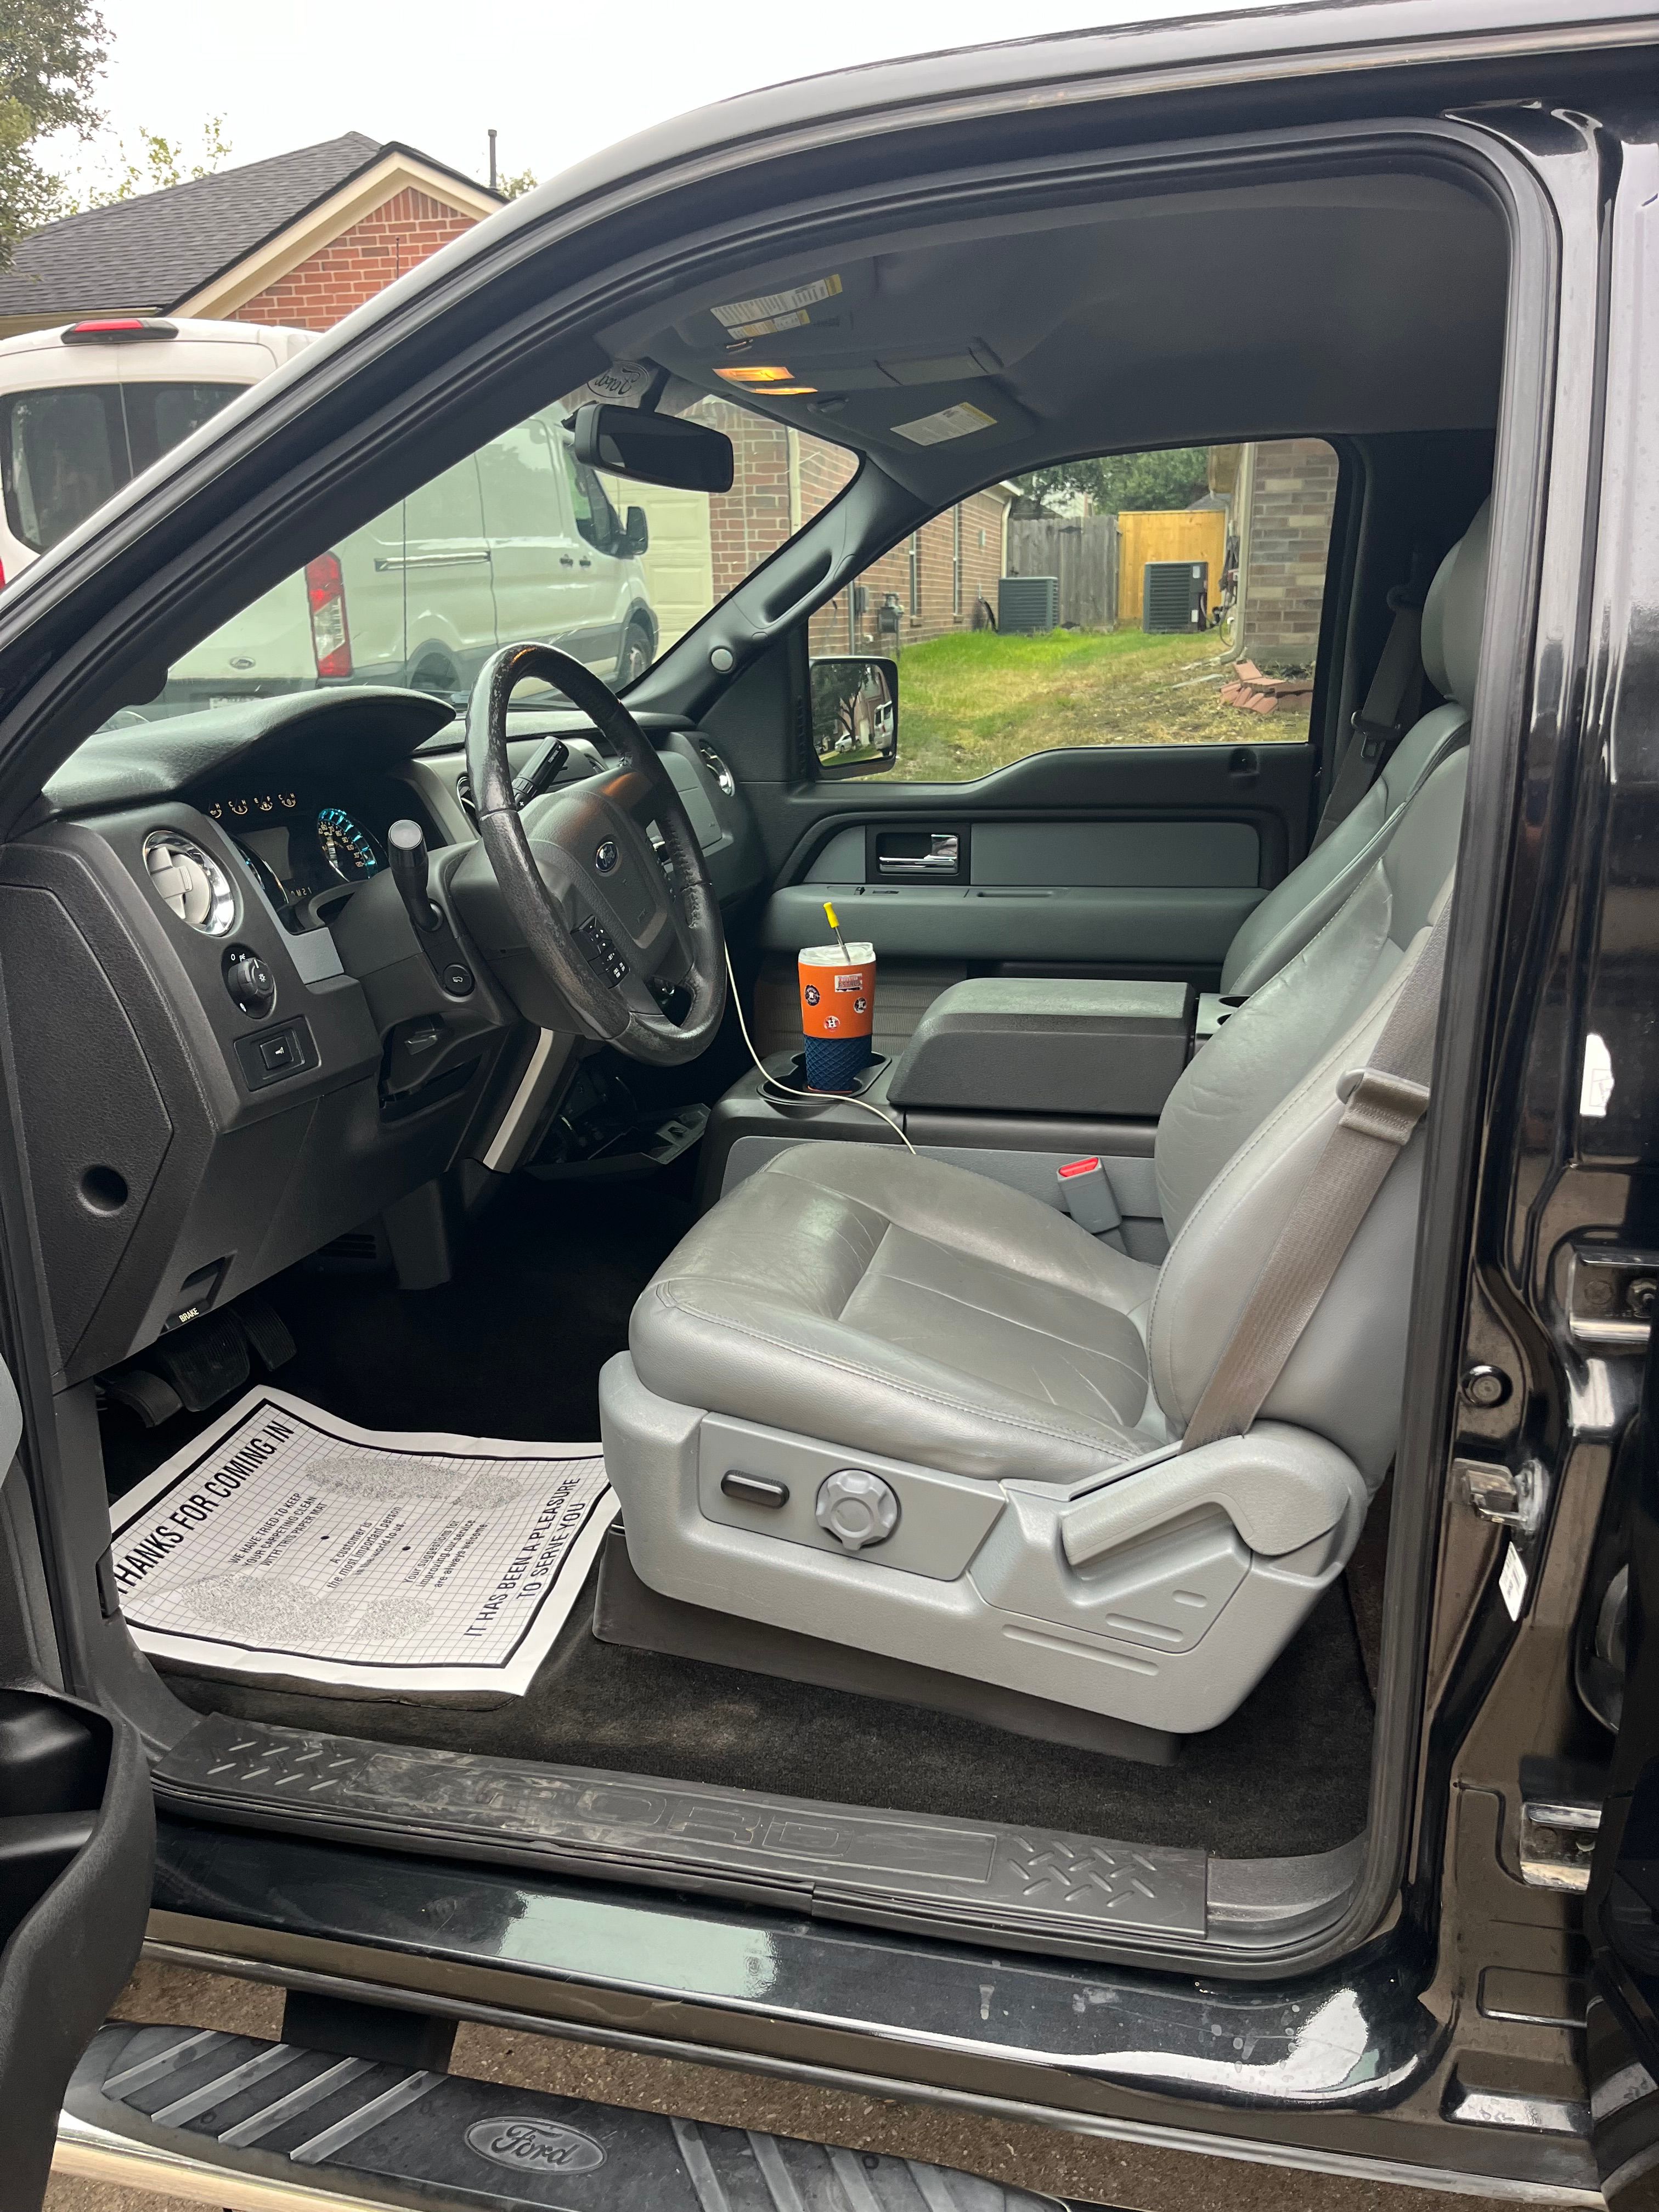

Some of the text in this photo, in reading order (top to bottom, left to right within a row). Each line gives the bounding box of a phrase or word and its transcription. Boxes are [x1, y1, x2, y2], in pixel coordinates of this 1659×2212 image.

[178, 1307, 199, 1322] BRAKE
[169, 1494, 219, 1531] FOR
[205, 1438, 278, 1498] COMING
[263, 1420, 295, 1443] IN
[228, 1492, 302, 1564] WE HAVE TRIED TO KEEP
[242, 1496, 318, 1566] YOUR CARPETING CLEAN
[261, 1502, 328, 1566] WITH THIS PAPER MAT
[326, 1577, 342, 1588] the
[339, 1558, 357, 1576] most
[380, 1506, 402, 1527] person
[336, 1528, 366, 1557] customer
[370, 1539, 391, 1557] world
[403, 1568, 421, 1583] Your
[417, 1530, 452, 1567] suggestions
[416, 1520, 476, 1587] improving our service
[464, 1477, 581, 1636] IT HAS BEEN A PLEASURE
[516, 1502, 585, 1599] TO SERVE YOU
[435, 1576, 448, 1588] are
[444, 1551, 466, 1574] always
[491, 2124, 580, 2166] Ford
